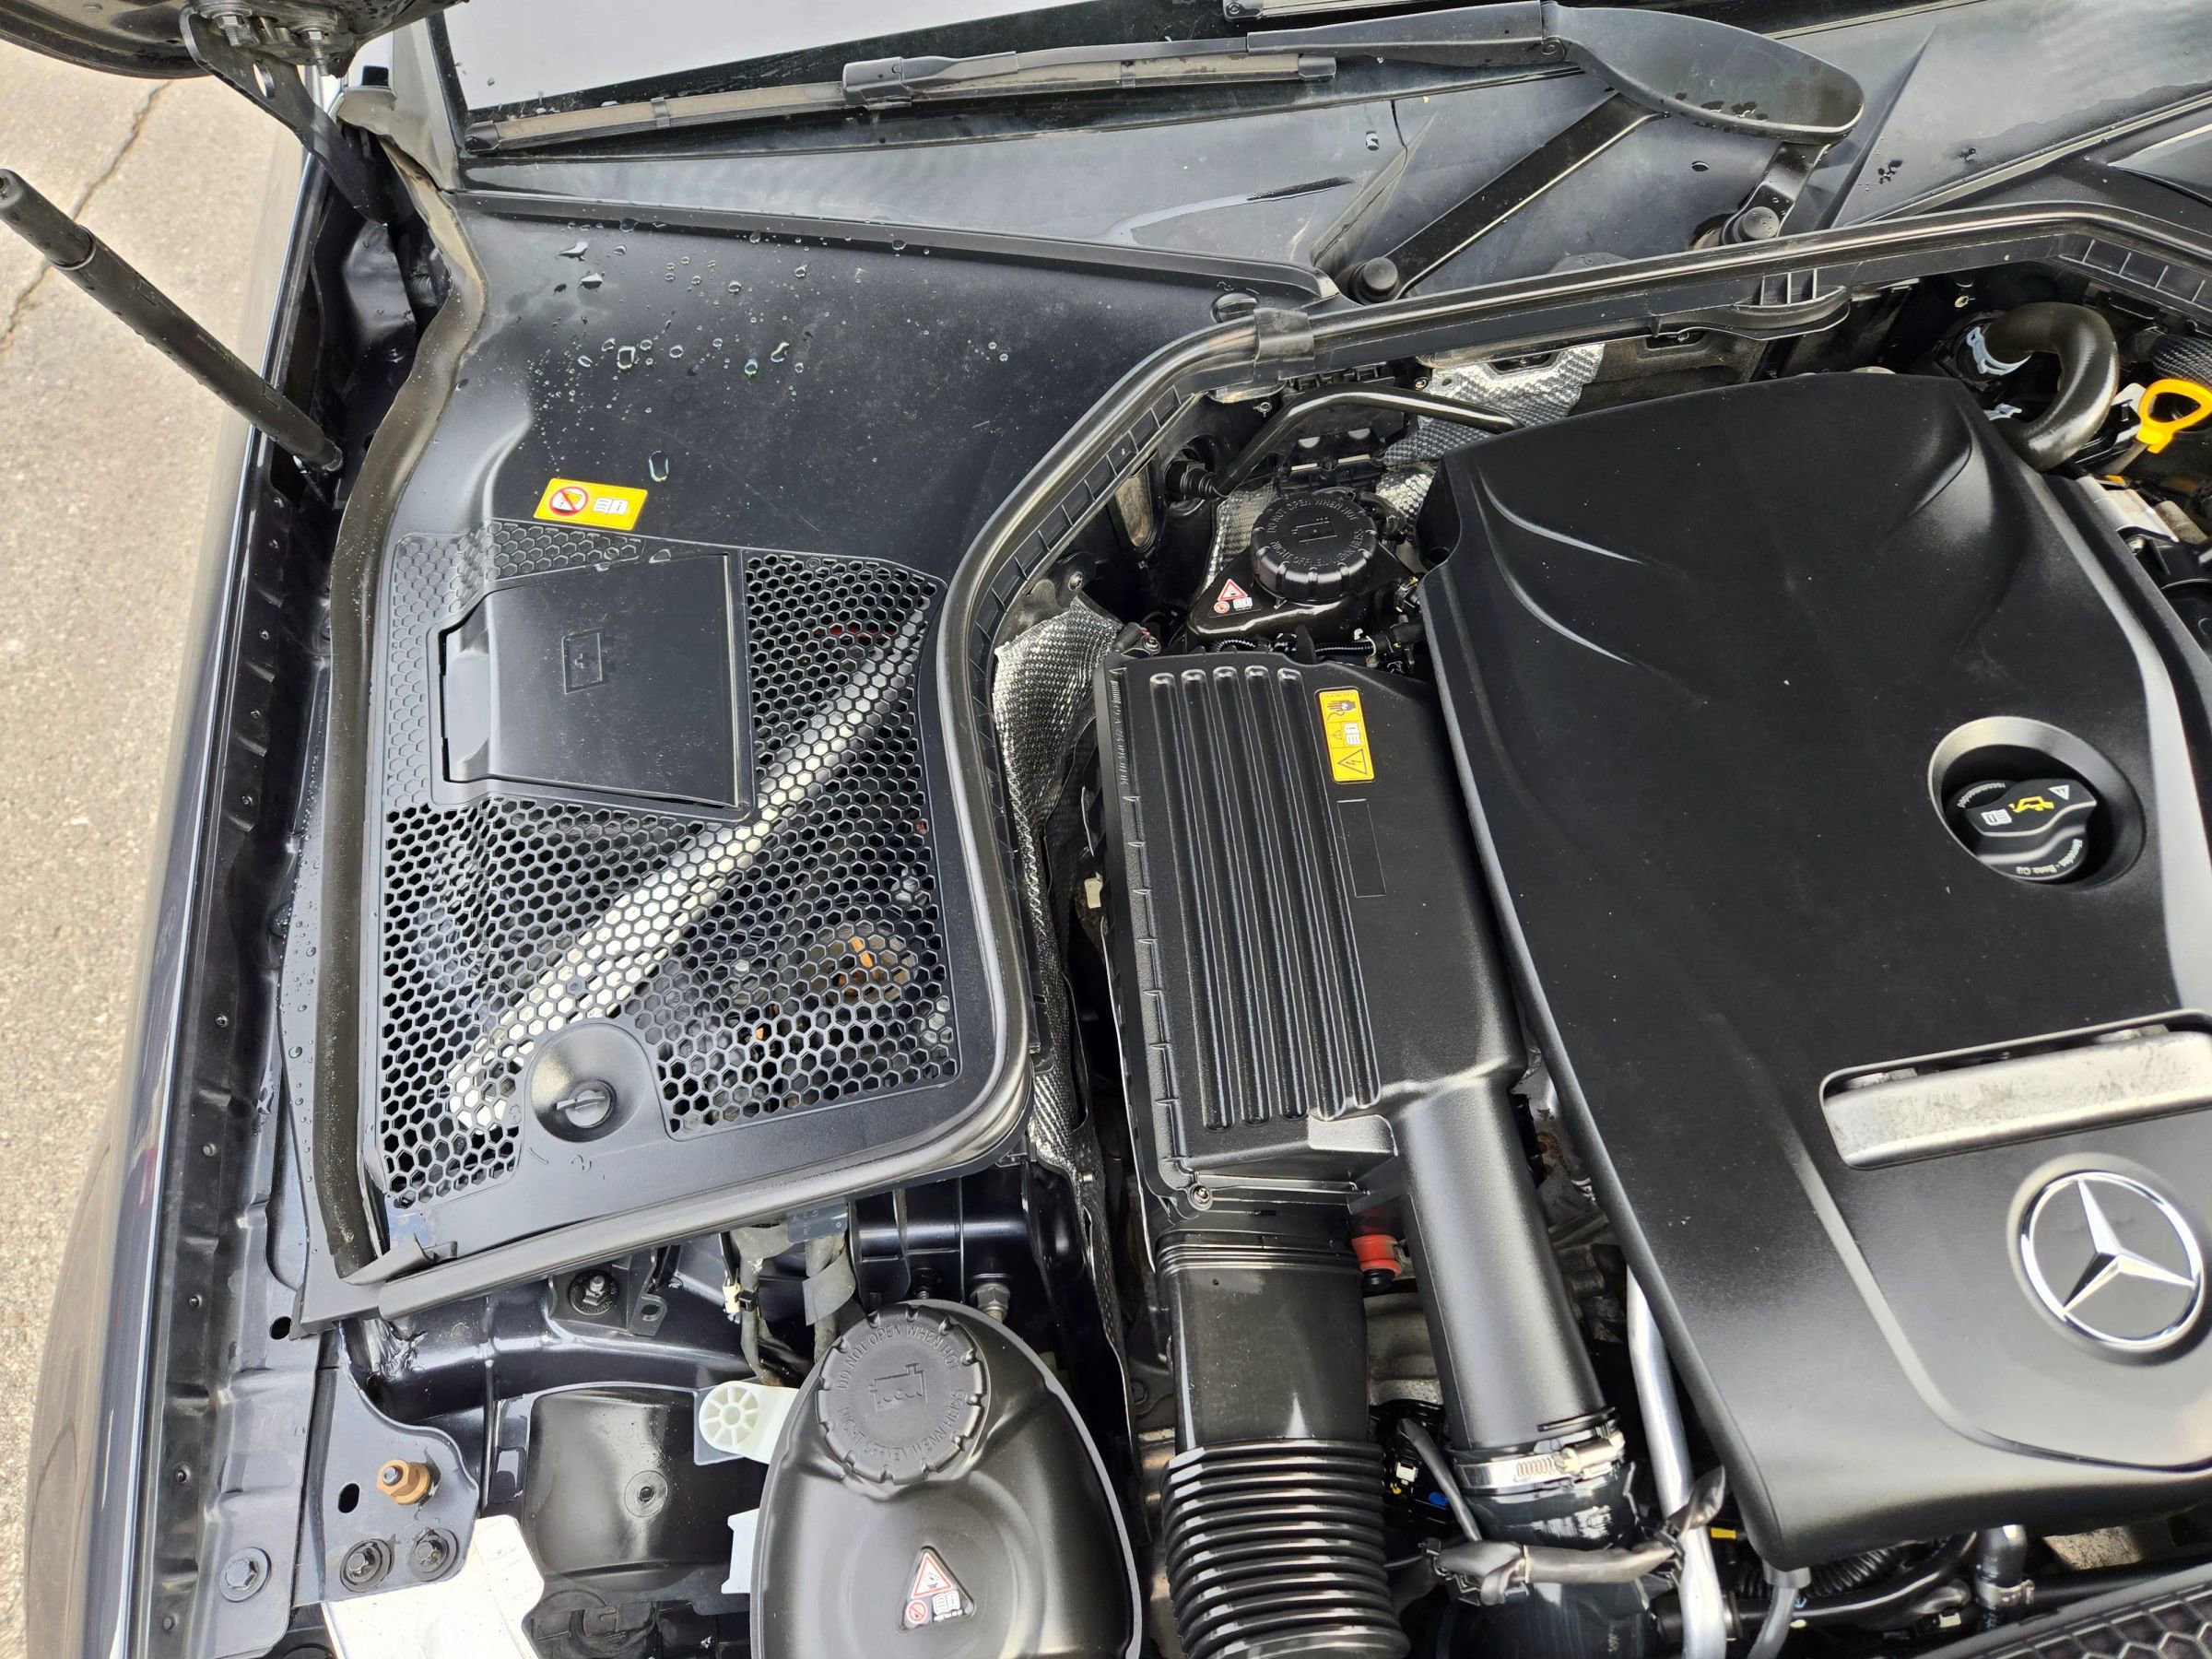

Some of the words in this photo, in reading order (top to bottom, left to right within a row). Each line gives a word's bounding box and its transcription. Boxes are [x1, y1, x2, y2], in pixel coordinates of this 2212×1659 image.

[837, 1370, 850, 1389] DO
[845, 1340, 868, 1368] NOT
[867, 1324, 901, 1347] OPEN
[906, 1324, 941, 1349] WHEN
[938, 1344, 960, 1371] HOT
